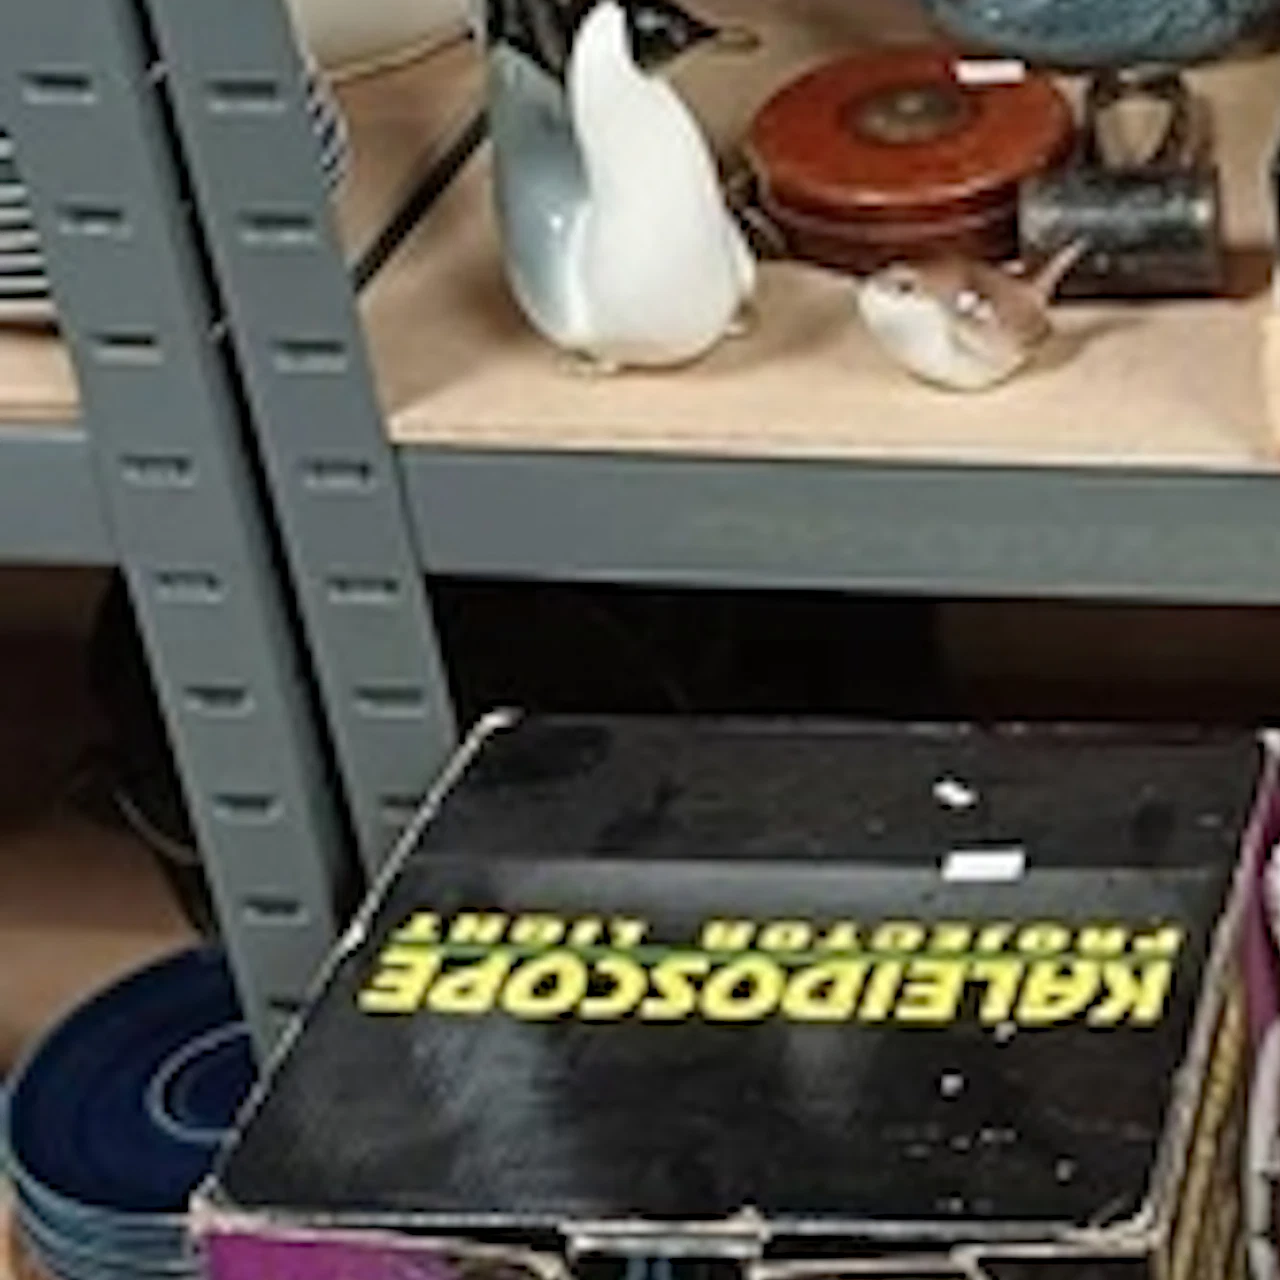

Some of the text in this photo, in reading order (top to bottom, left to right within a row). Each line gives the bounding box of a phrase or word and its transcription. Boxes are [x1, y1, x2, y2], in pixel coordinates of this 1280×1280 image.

[396, 912, 1181, 956] PROJECTOR LIGHT
[359, 948, 1172, 1024] KALEIDOSCOPE
